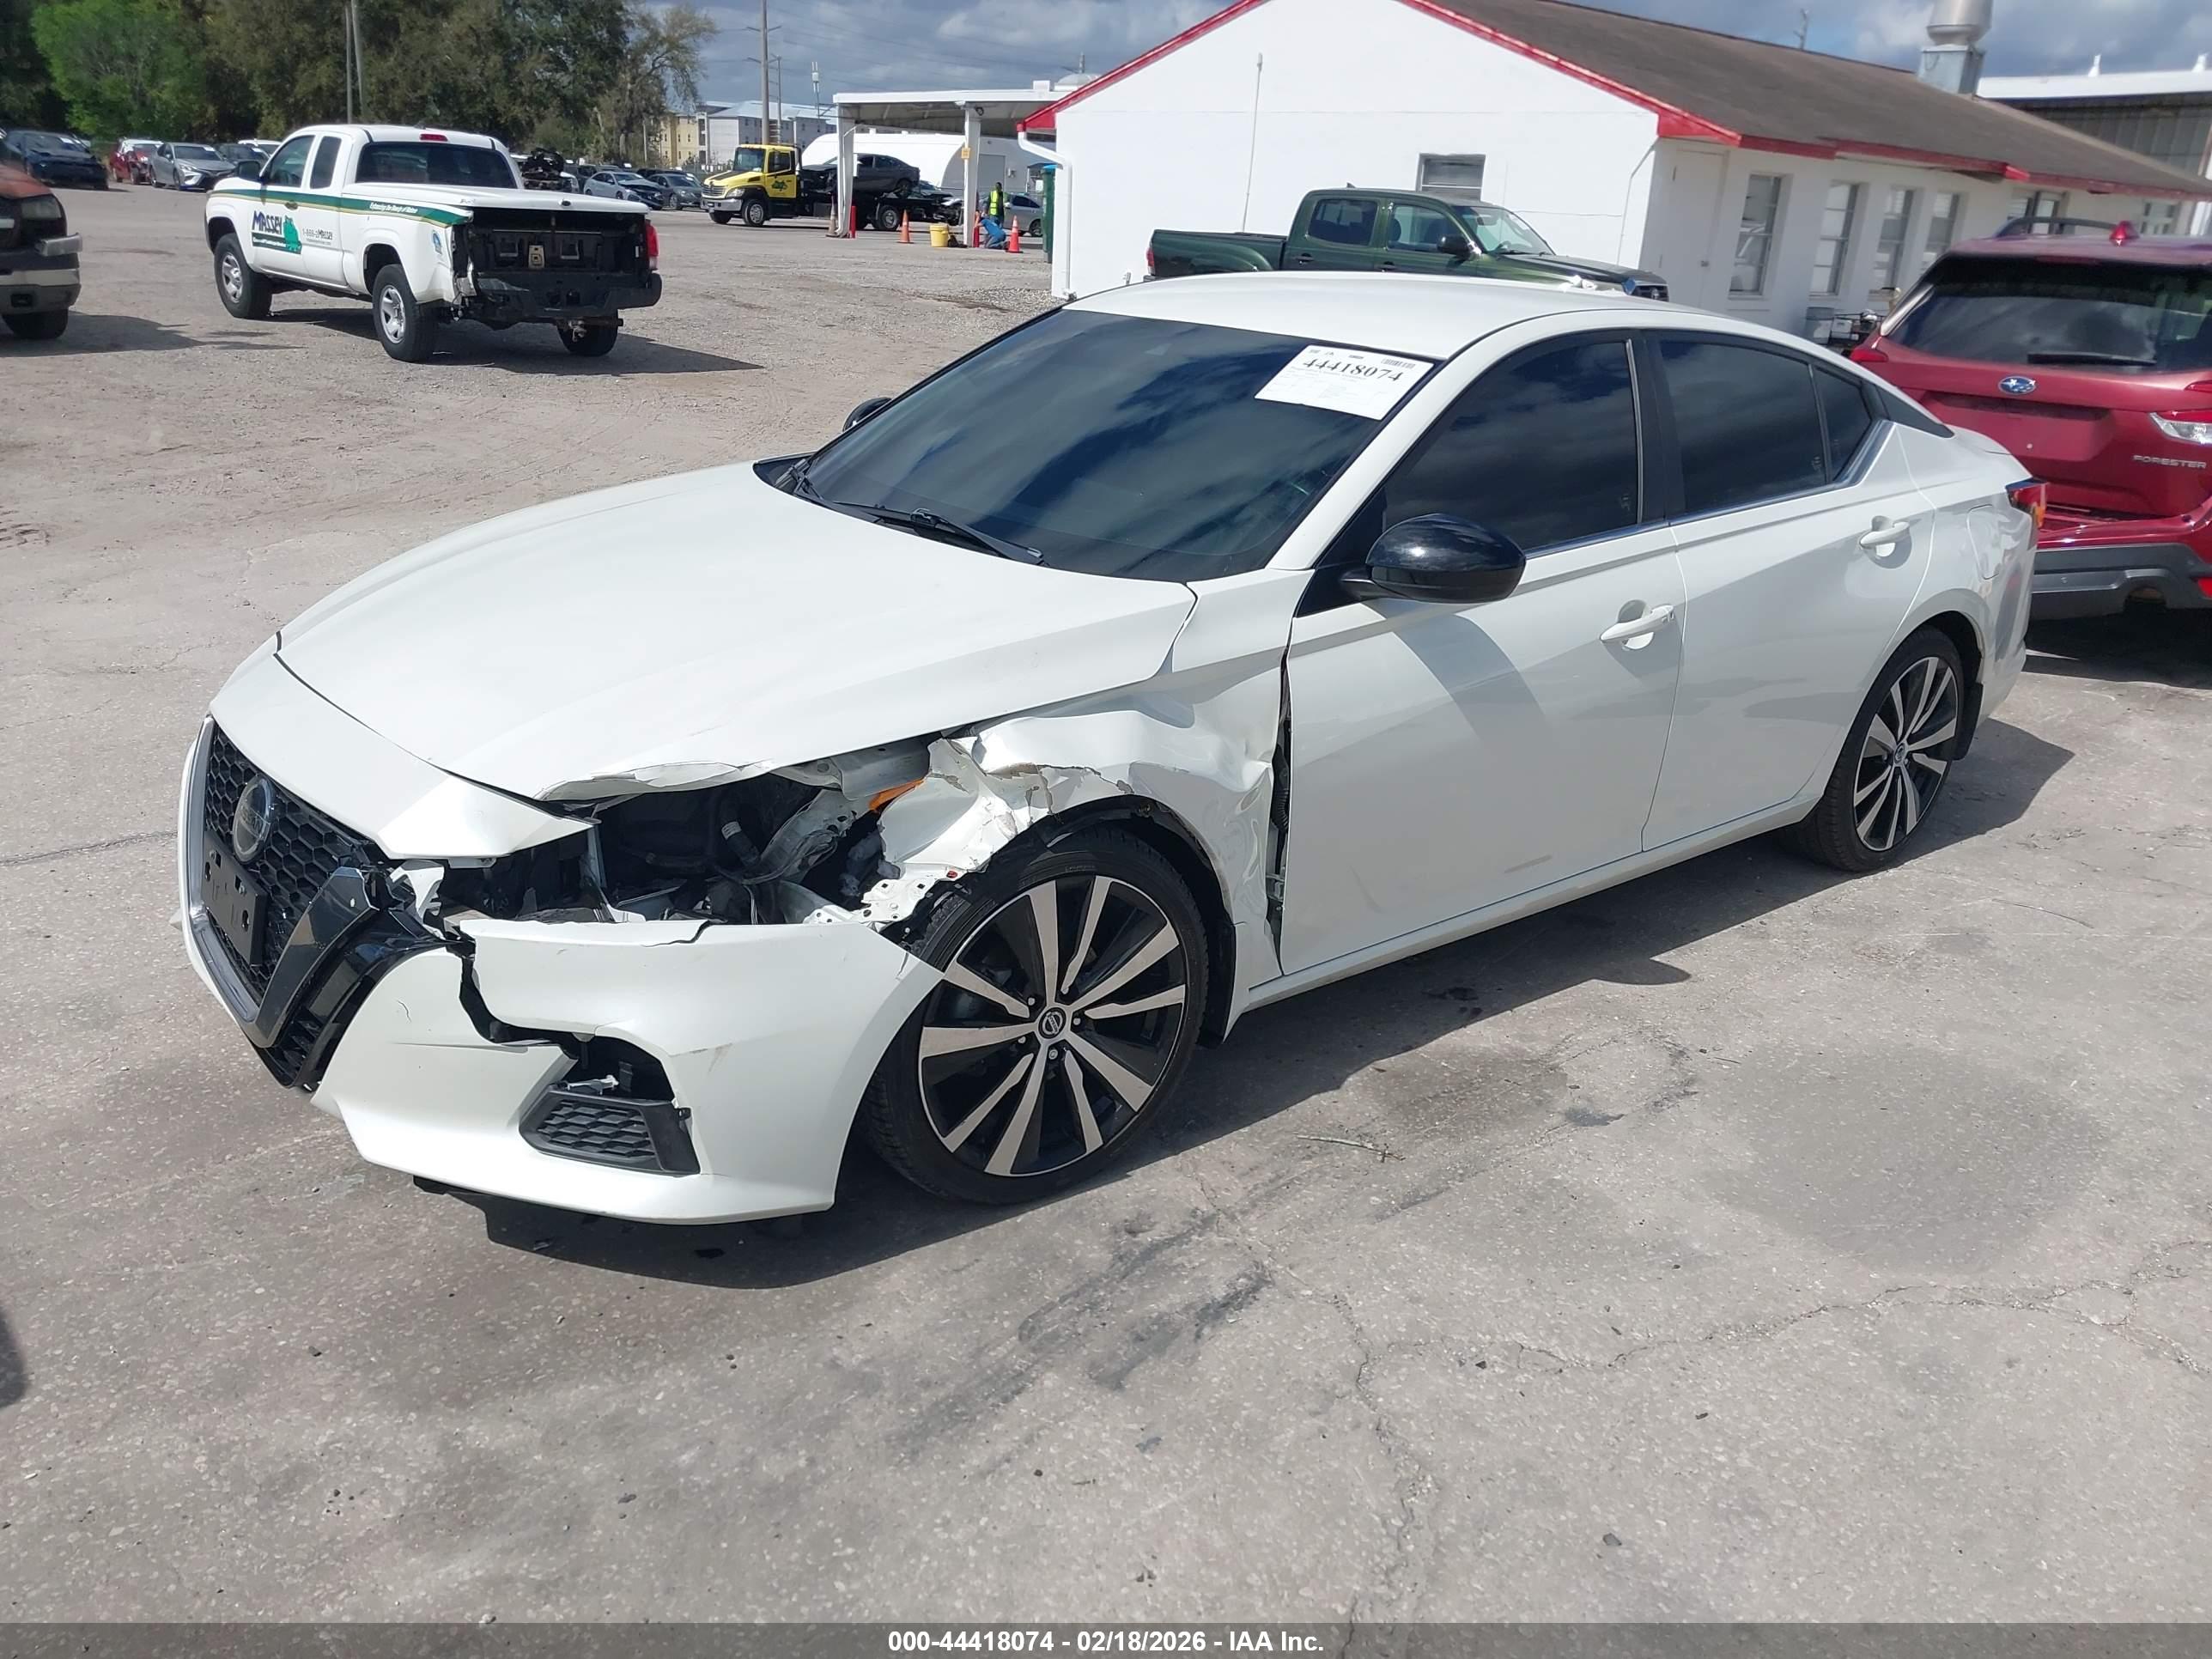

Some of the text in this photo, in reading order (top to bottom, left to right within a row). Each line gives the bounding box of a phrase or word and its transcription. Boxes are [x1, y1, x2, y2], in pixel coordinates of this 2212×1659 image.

[252, 210, 282, 235] MASSEY
[1303, 358, 1403, 381] 44418074
[2133, 454, 2207, 469] FORESTER
